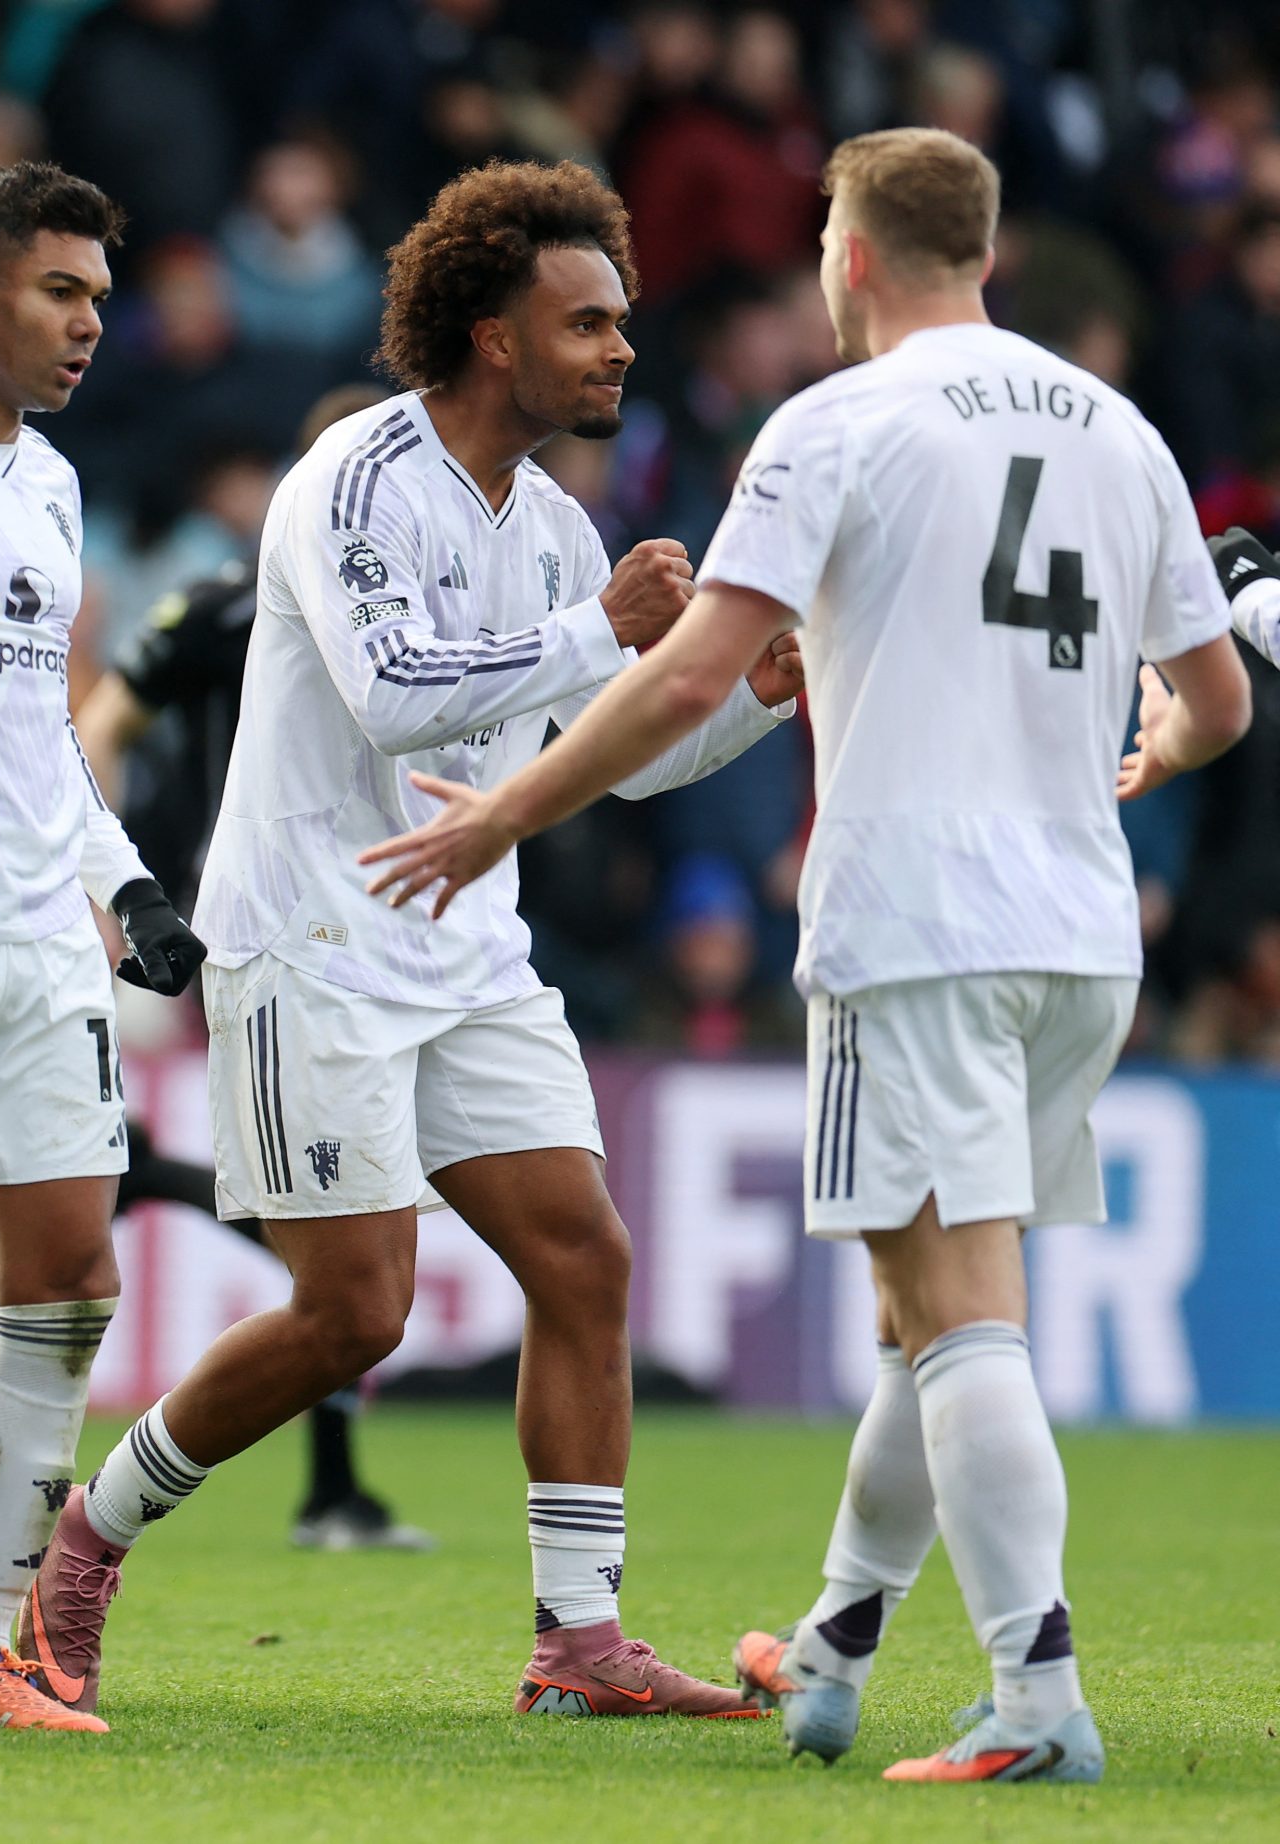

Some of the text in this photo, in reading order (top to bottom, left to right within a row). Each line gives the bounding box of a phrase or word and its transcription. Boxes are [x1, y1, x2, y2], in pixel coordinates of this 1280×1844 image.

[942, 374, 1102, 428] DE LIGT
[982, 455, 1098, 670] 4
[348, 600, 404, 621] No room
[369, 609, 412, 622] racism
